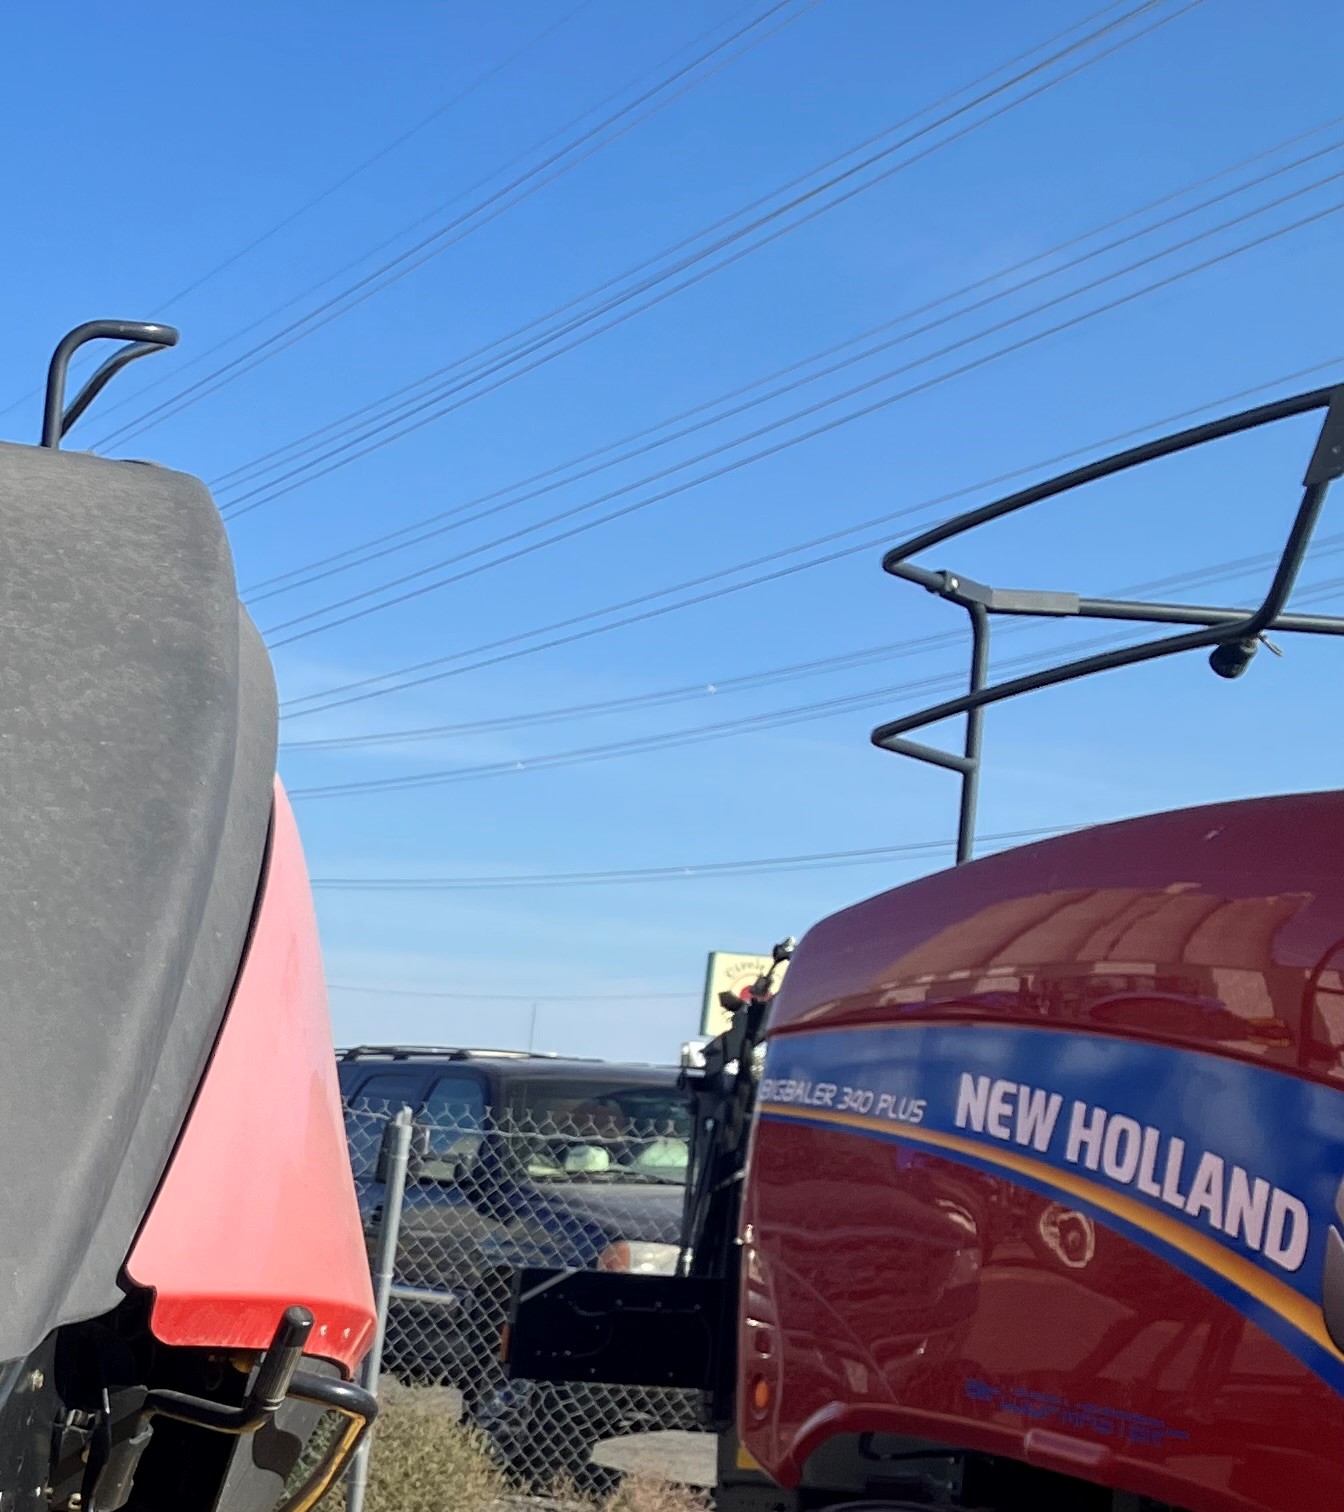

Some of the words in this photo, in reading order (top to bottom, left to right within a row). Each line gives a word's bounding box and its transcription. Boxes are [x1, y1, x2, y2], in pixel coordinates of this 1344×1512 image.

[837, 1087, 875, 1114] 340
[875, 1093, 928, 1124] PLUS
[955, 1072, 1063, 1153] NEW
[1065, 1100, 1310, 1273] HOLLAND
